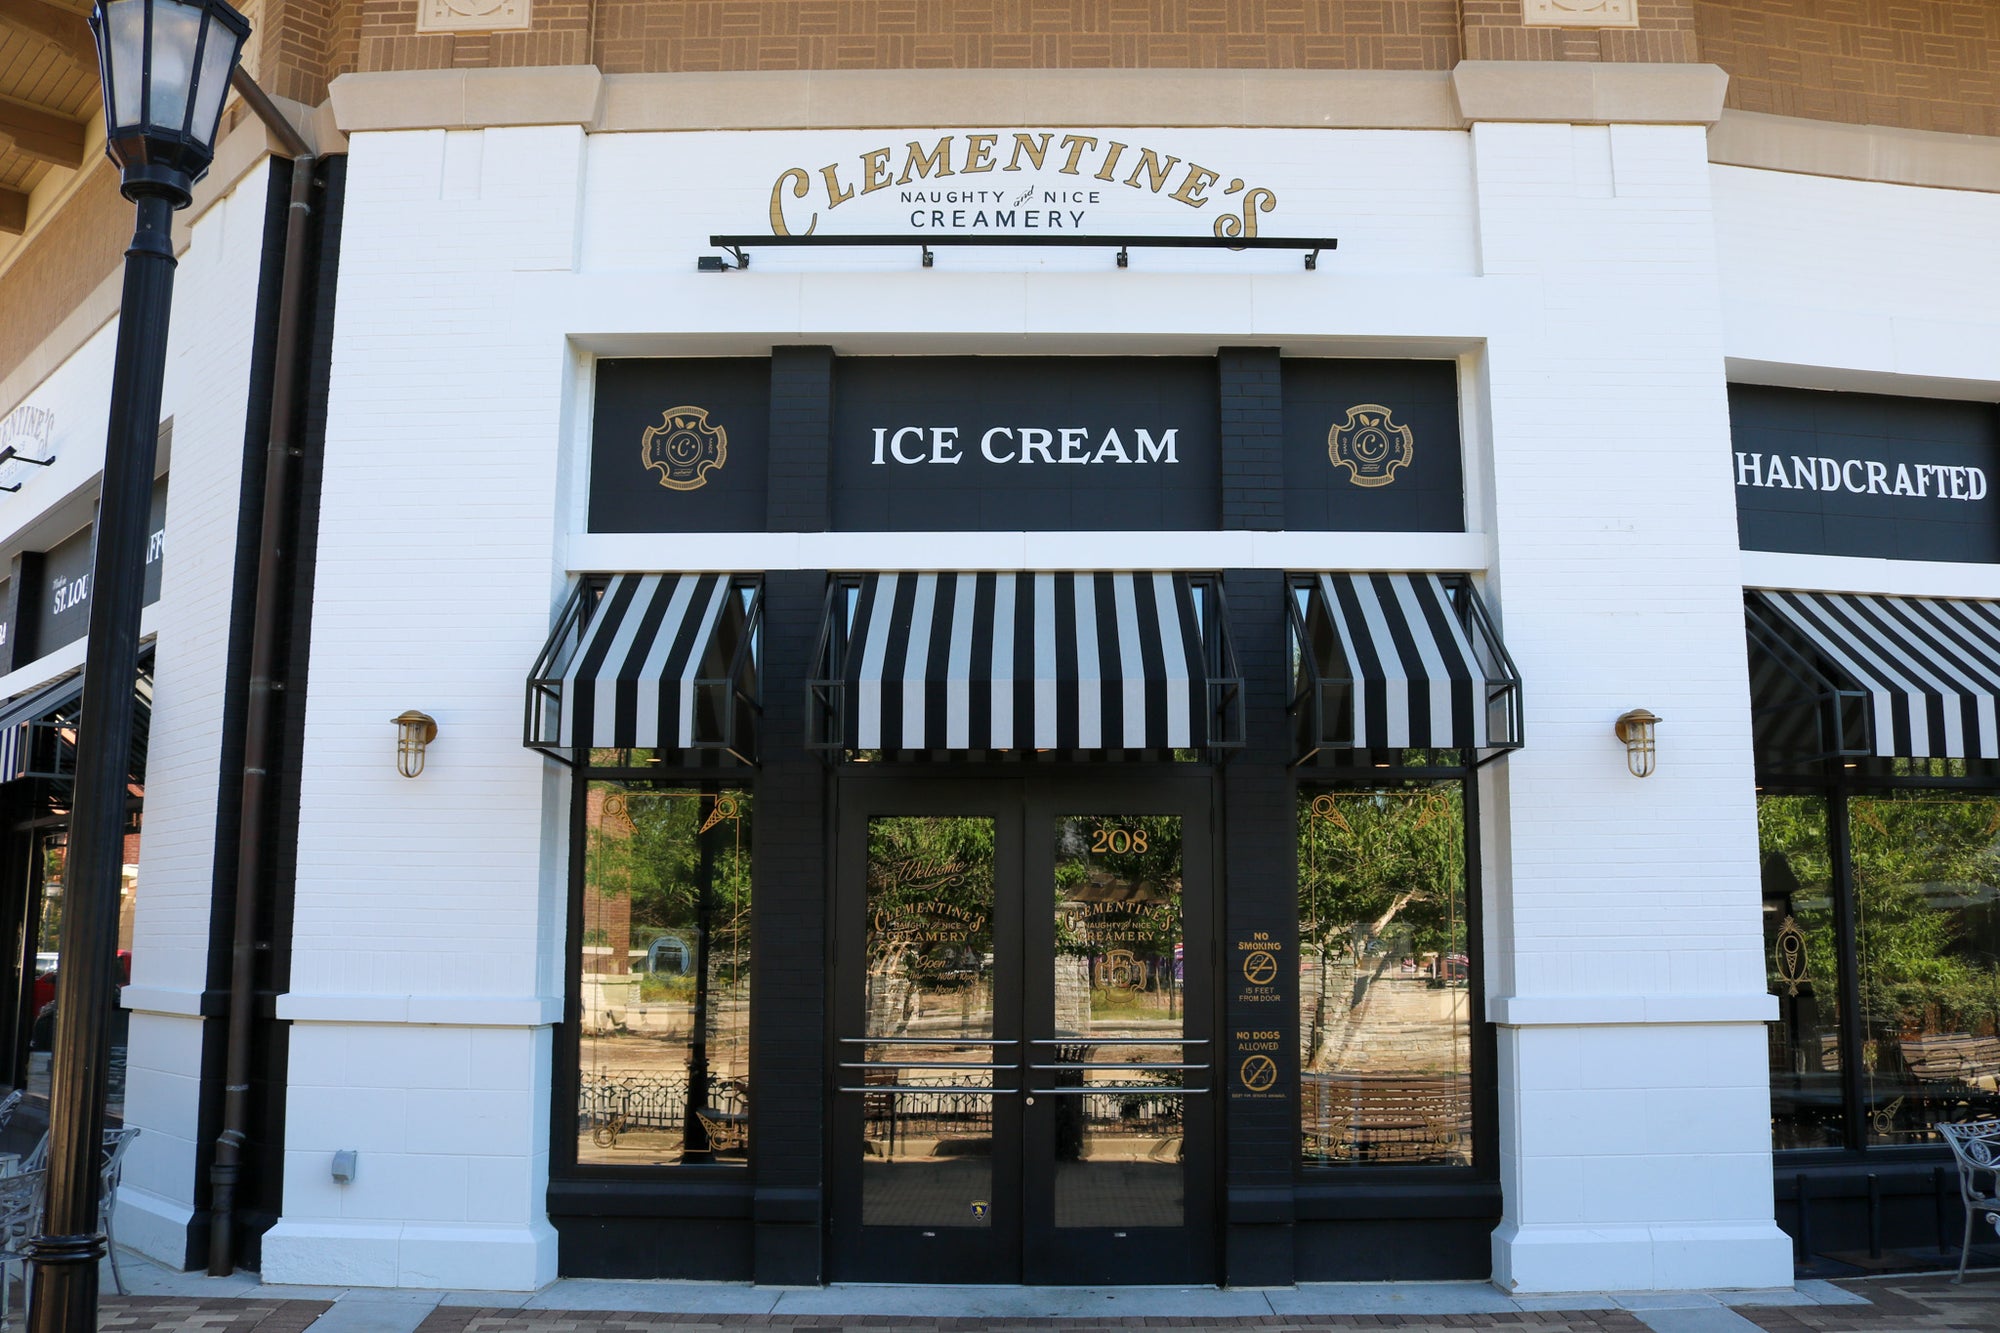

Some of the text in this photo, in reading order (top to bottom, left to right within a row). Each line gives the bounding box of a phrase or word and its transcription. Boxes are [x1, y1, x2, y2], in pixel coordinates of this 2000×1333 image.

[768, 133, 1277, 250] CLEMENTINE'S
[900, 184, 1100, 208] NAUGHTY and NICE
[910, 209, 1085, 229] CREAMERY
[871, 427, 1180, 465] ICE CREAM
[1735, 452, 1987, 501] HANDCRAFTED
[53, 586, 67, 615] ST.
[1091, 829, 1149, 854] 208
[898, 859, 968, 882] Welcome
[875, 901, 985, 932] CLEMENTINE'S
[894, 921, 931, 930] NAUGHTY
[943, 921, 961, 930] NICE
[1064, 901, 1175, 932] CLEMENTINE'S
[1084, 921, 1121, 930] NAUGHTY
[1132, 921, 1152, 930] NICE
[886, 931, 968, 942] CREAMERY
[1077, 931, 1155, 941] CREAMERY
[1254, 932, 1269, 941] NO
[1238, 942, 1281, 951] SMOKING
[915, 955, 947, 972] Open
[1236, 1031, 1281, 1040] NO DOGS
[1238, 1042, 1279, 1051] ALLOWED
